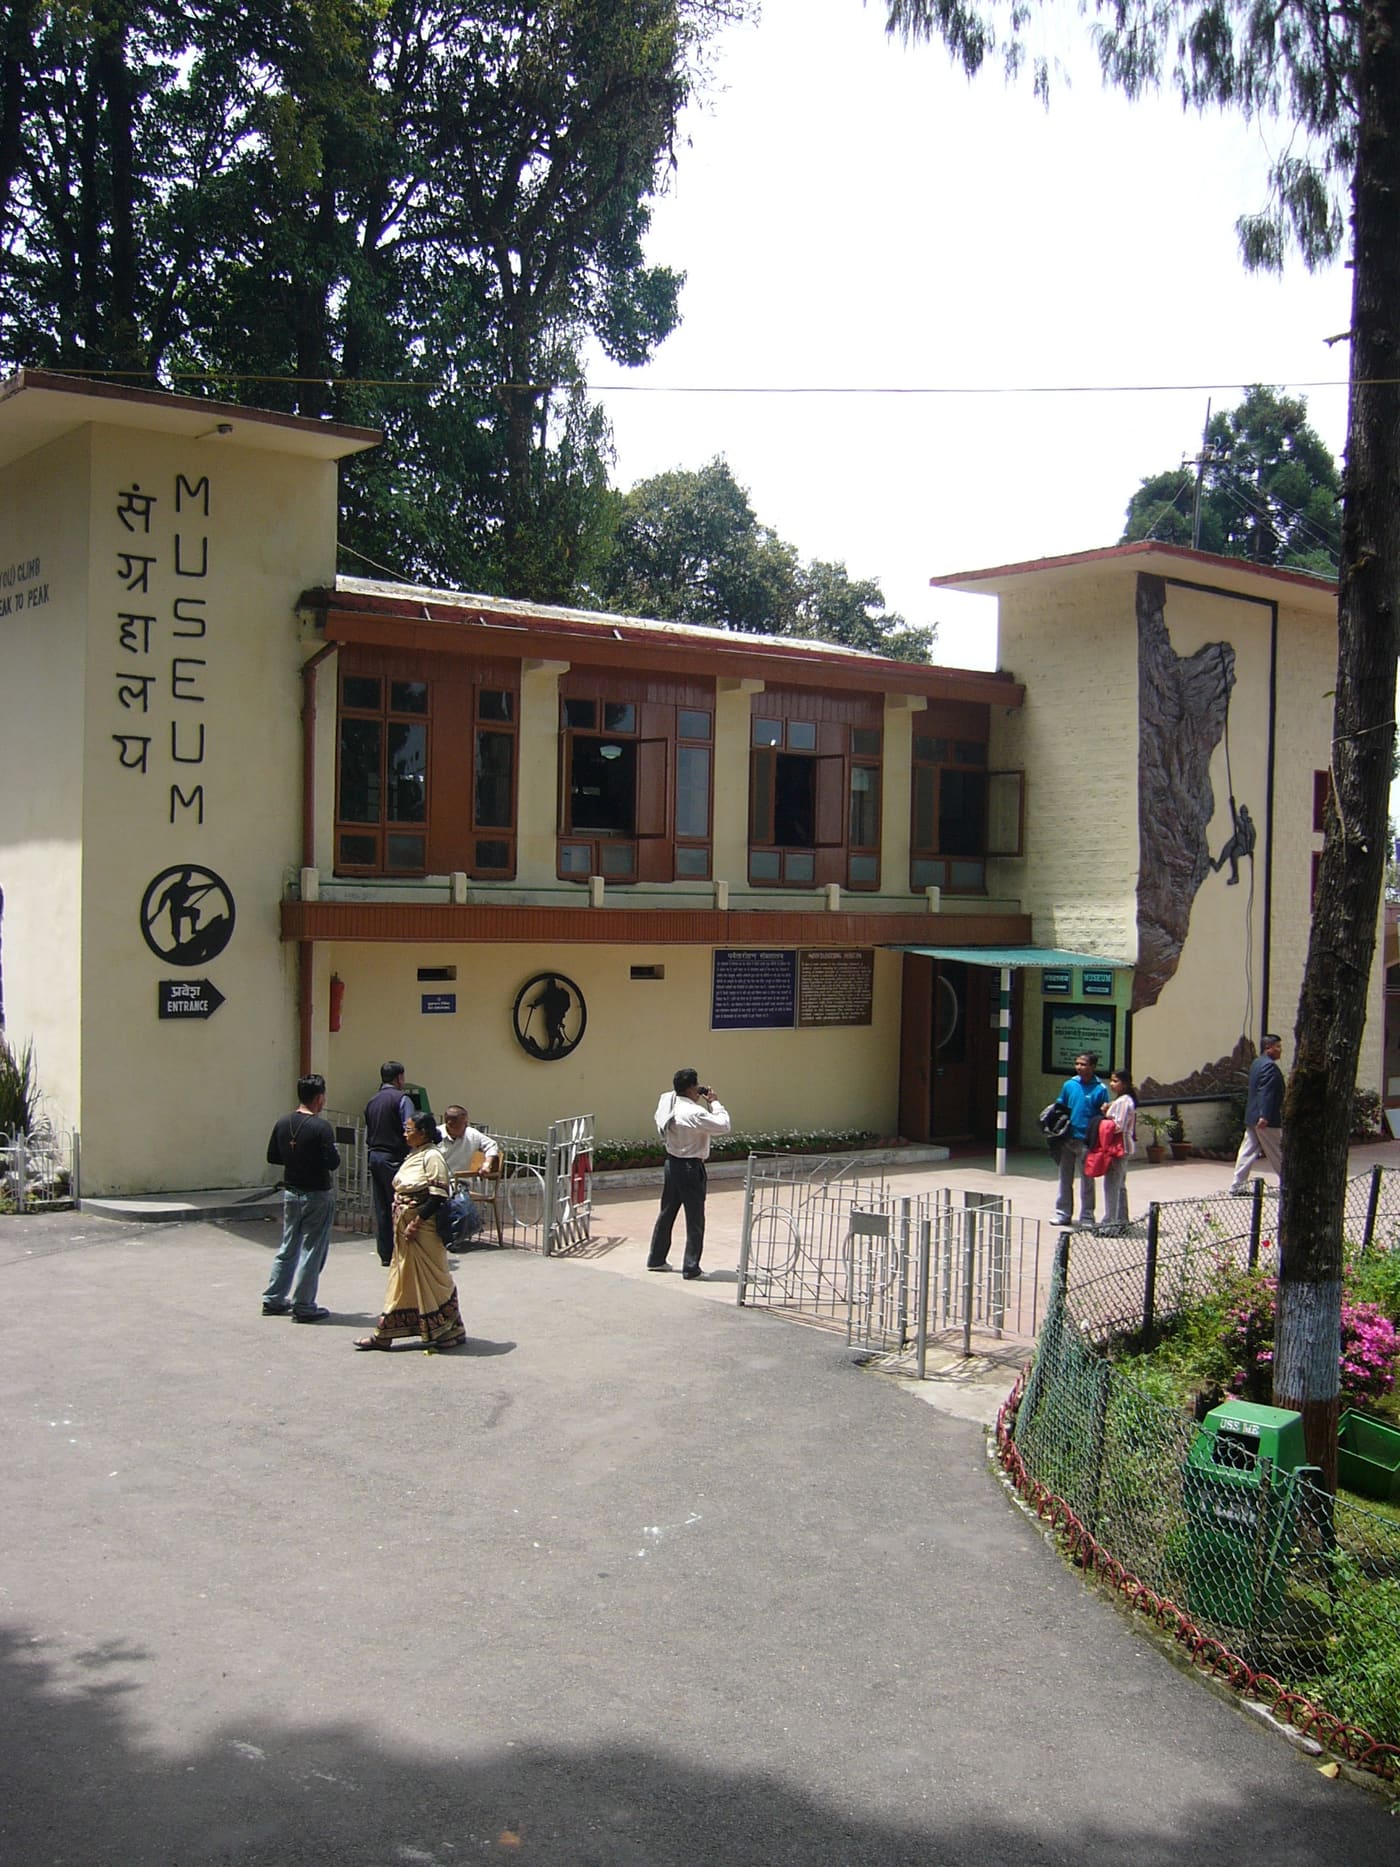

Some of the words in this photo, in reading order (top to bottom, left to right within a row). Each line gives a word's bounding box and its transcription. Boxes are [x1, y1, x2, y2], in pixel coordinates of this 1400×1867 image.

[17, 557, 41, 581] CLIMB
[15, 593, 24, 612] TO
[28, 583, 49, 609] PEAK
[113, 481, 158, 774] संग्रहालय
[169, 474, 210, 825] MUSEUM
[170, 983, 201, 998] प्रवेश
[167, 1000, 209, 1012] ENTRANCE
